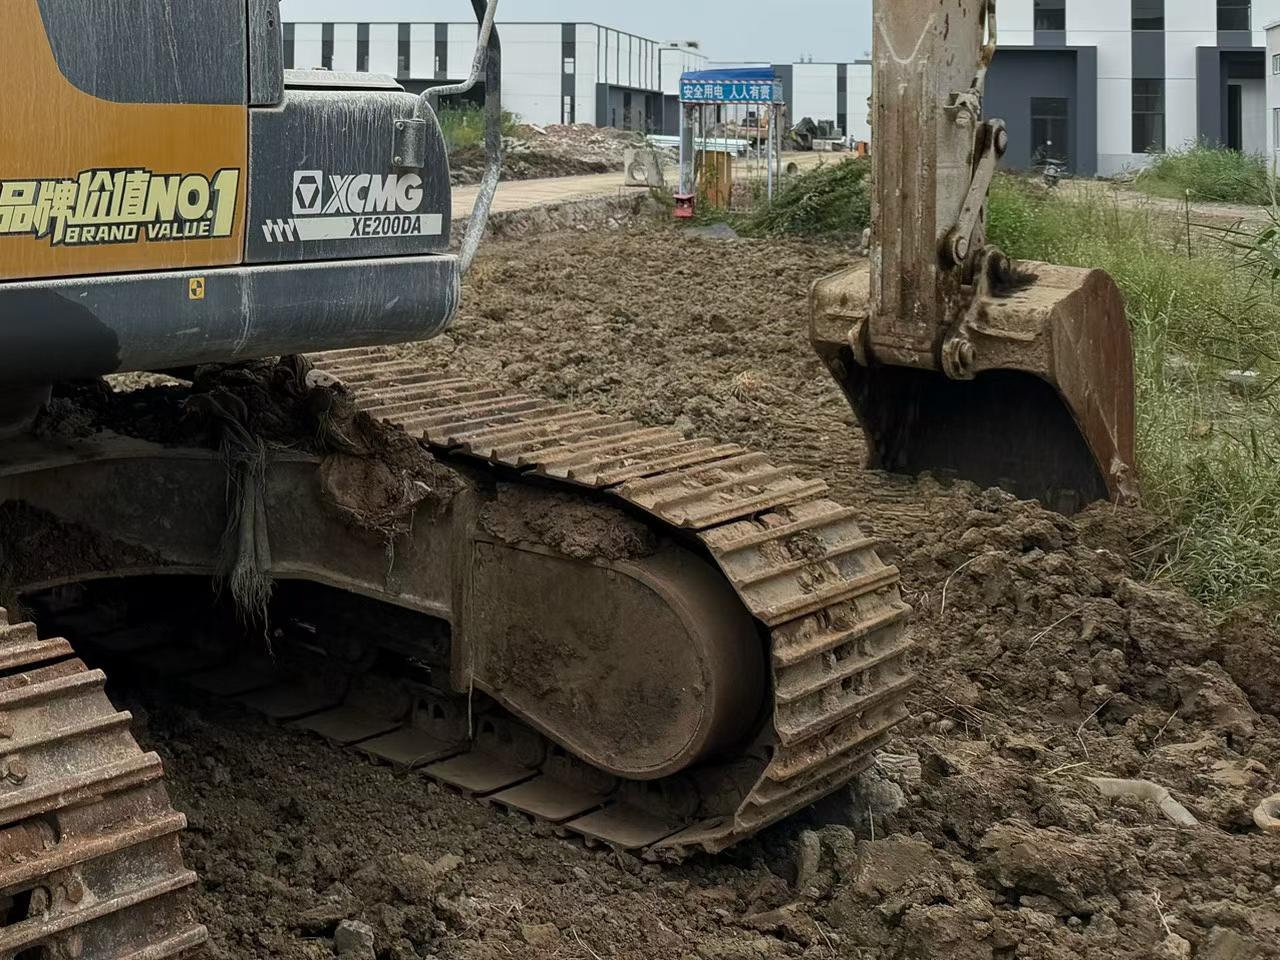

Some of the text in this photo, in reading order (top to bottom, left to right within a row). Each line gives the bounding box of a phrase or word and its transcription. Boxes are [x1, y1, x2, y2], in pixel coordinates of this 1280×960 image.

[683, 84, 770, 100] 安全用电 人人有责
[322, 173, 423, 214] XCMG
[65, 220, 211, 244] BRAND VALUE
[350, 215, 422, 237] XE200DA
